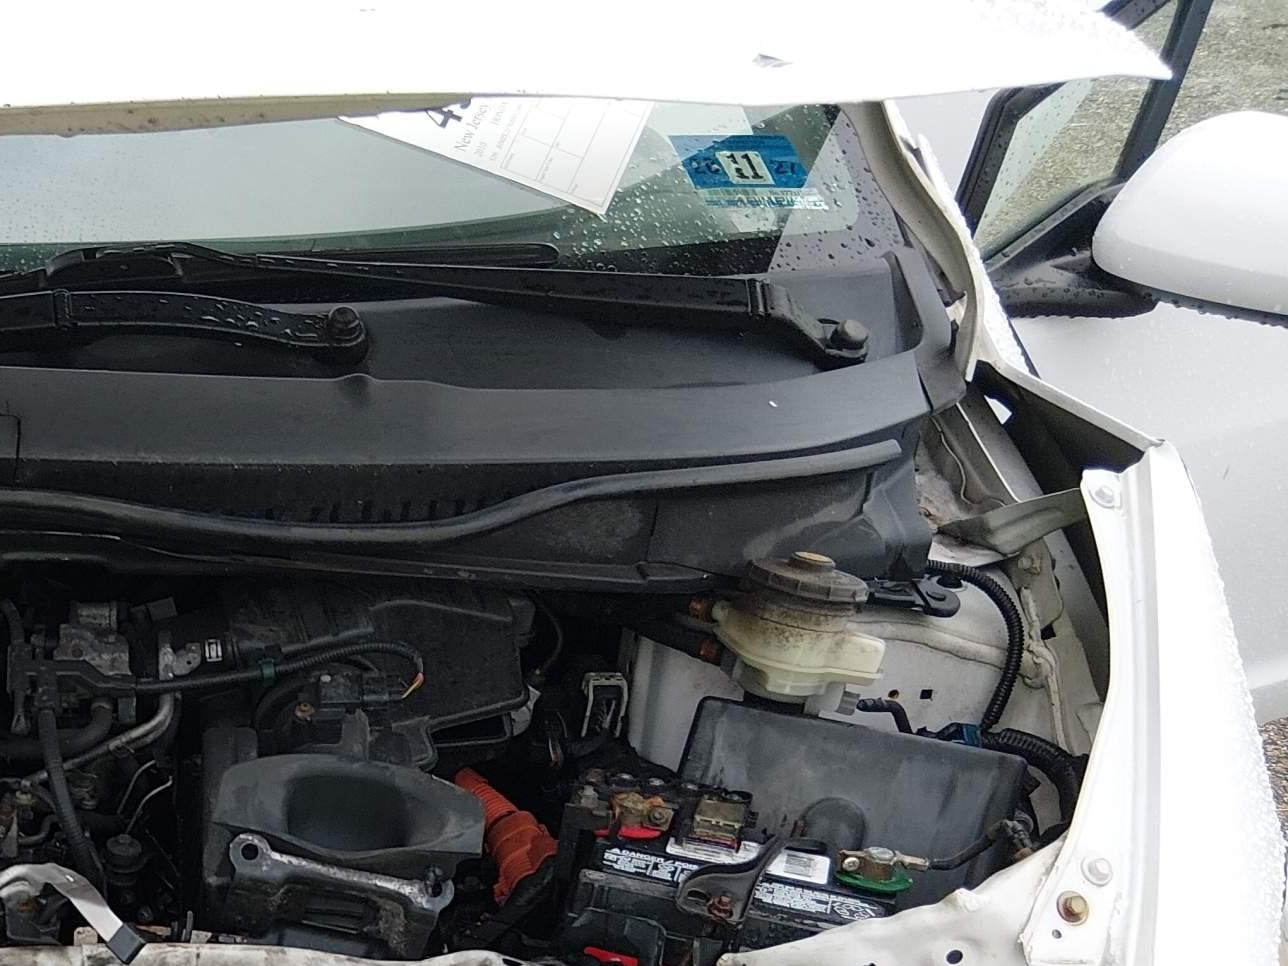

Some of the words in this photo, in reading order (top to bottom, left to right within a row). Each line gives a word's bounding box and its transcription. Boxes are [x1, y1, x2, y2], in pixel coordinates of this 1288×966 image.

[454, 129, 475, 152] New
[466, 104, 489, 130] Jersey
[622, 849, 665, 864] DANGER
